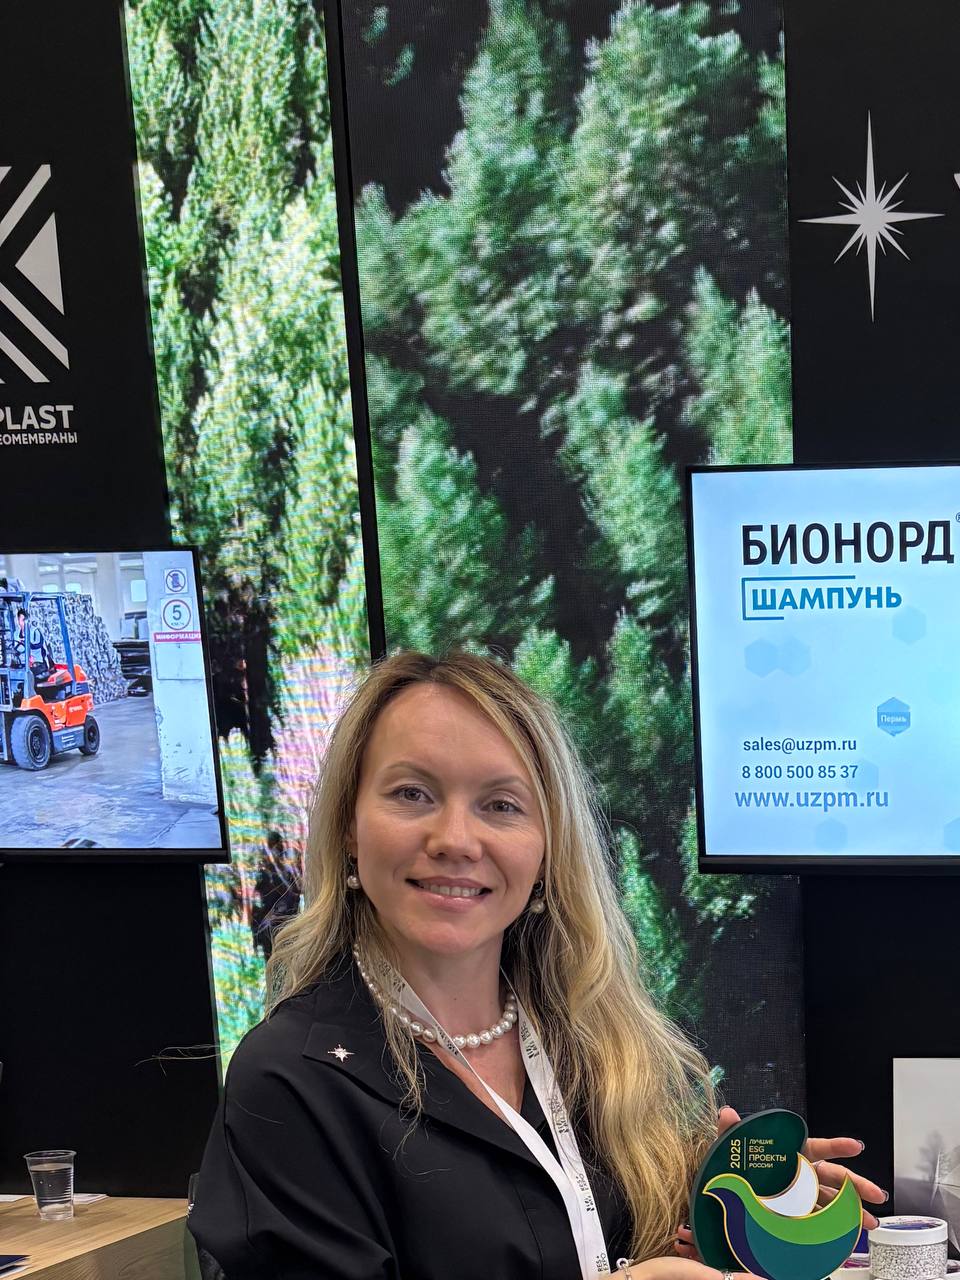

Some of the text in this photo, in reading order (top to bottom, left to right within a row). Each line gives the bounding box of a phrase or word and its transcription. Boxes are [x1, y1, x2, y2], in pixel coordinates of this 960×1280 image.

[752, 586, 903, 610] ШАМПУНЬ
[172, 604, 182, 621] 5
[743, 737, 857, 754] sales@uzpm.ru
[742, 765, 858, 779] 8 800 500 85 37
[735, 791, 889, 812] www.uzpm.ru
[730, 1139, 741, 1169] 2025
[748, 1154, 787, 1162] ПРОЕКТЫ
